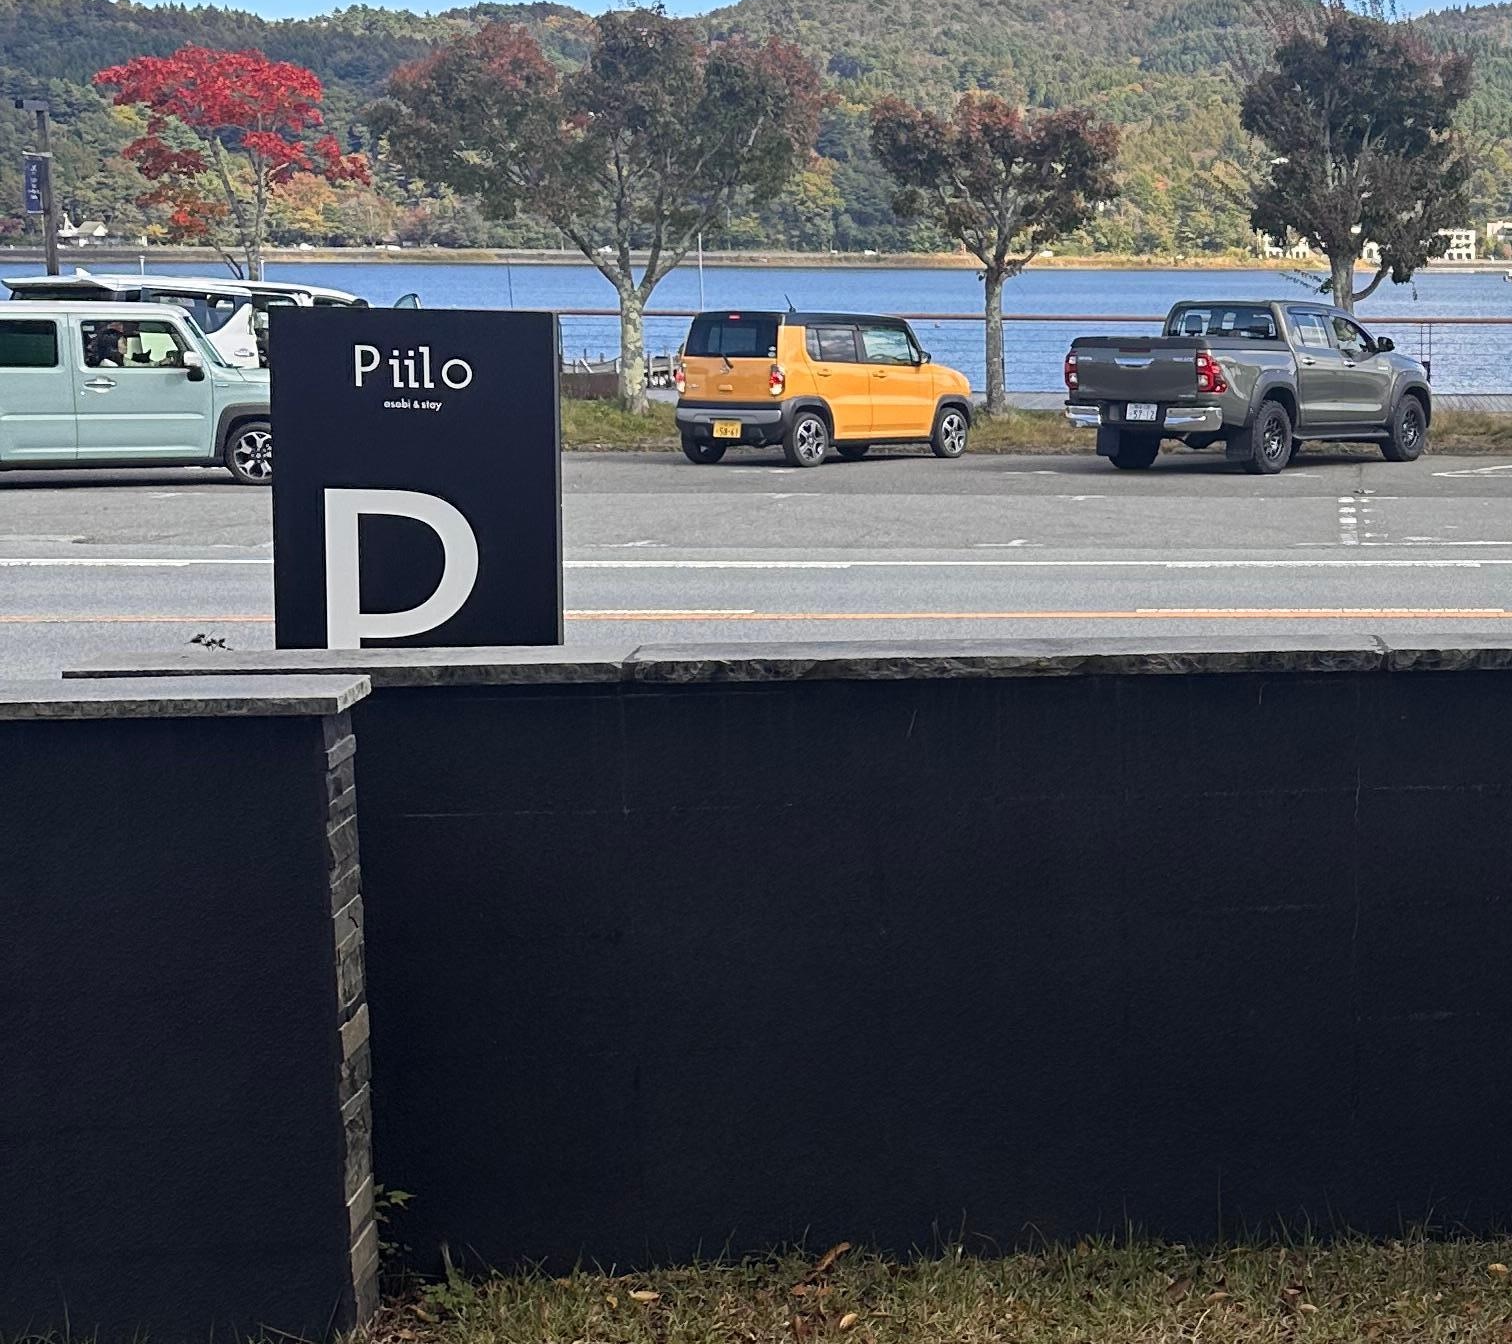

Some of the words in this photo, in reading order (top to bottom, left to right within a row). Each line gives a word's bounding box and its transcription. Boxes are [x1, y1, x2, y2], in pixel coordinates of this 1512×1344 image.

[354, 344, 473, 390] Piilo
[412, 400, 420, 409] &
[421, 400, 443, 412] stay
[324, 488, 479, 649] P
